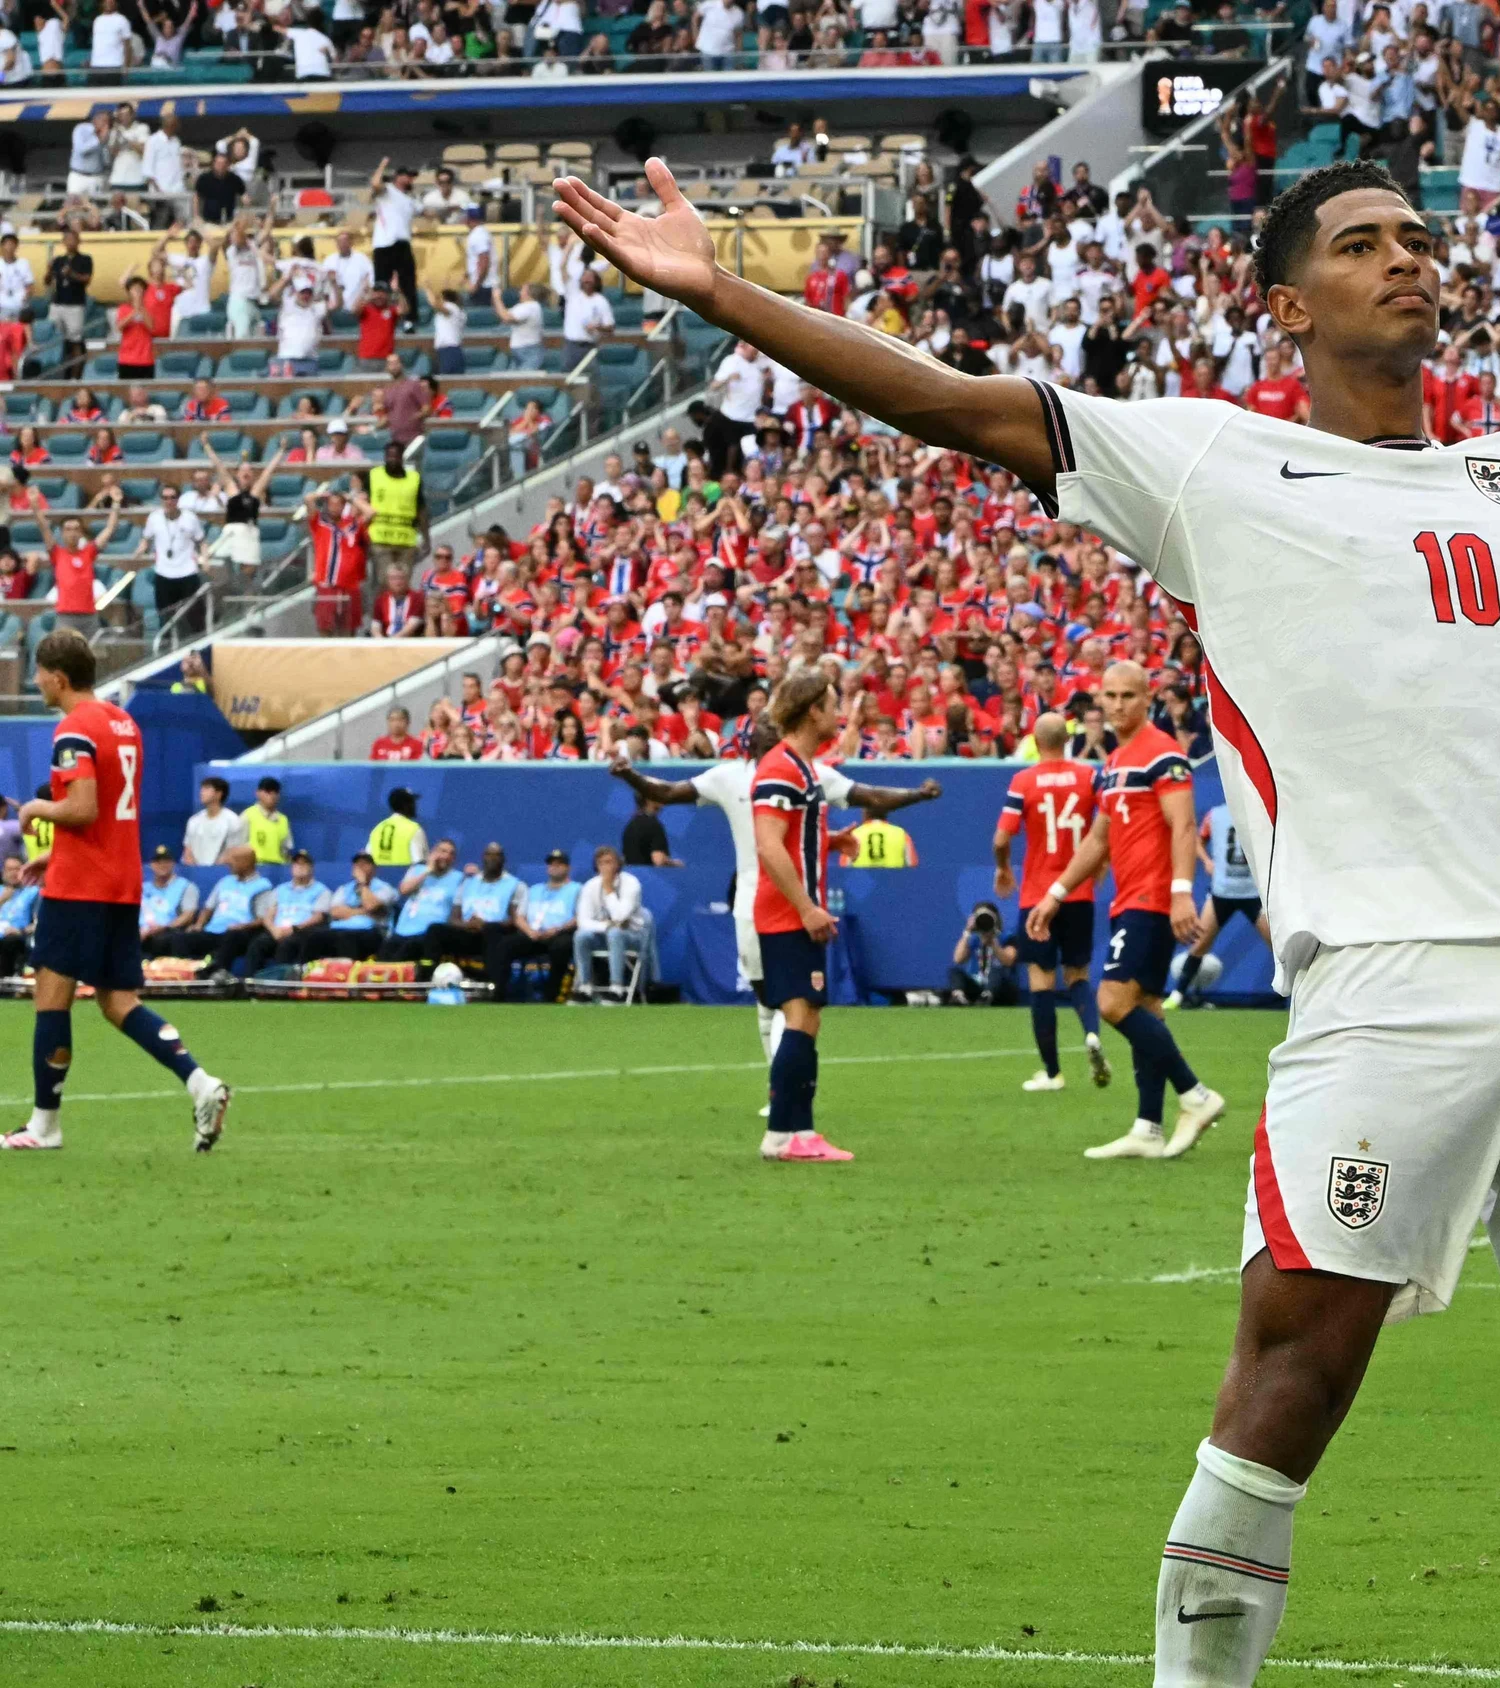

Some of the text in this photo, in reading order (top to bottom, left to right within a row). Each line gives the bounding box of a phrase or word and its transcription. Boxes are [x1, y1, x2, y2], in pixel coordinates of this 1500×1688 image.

[1037, 792, 1085, 854] 14
[1115, 793, 1130, 824] 4
[1110, 928, 1128, 960] 4
